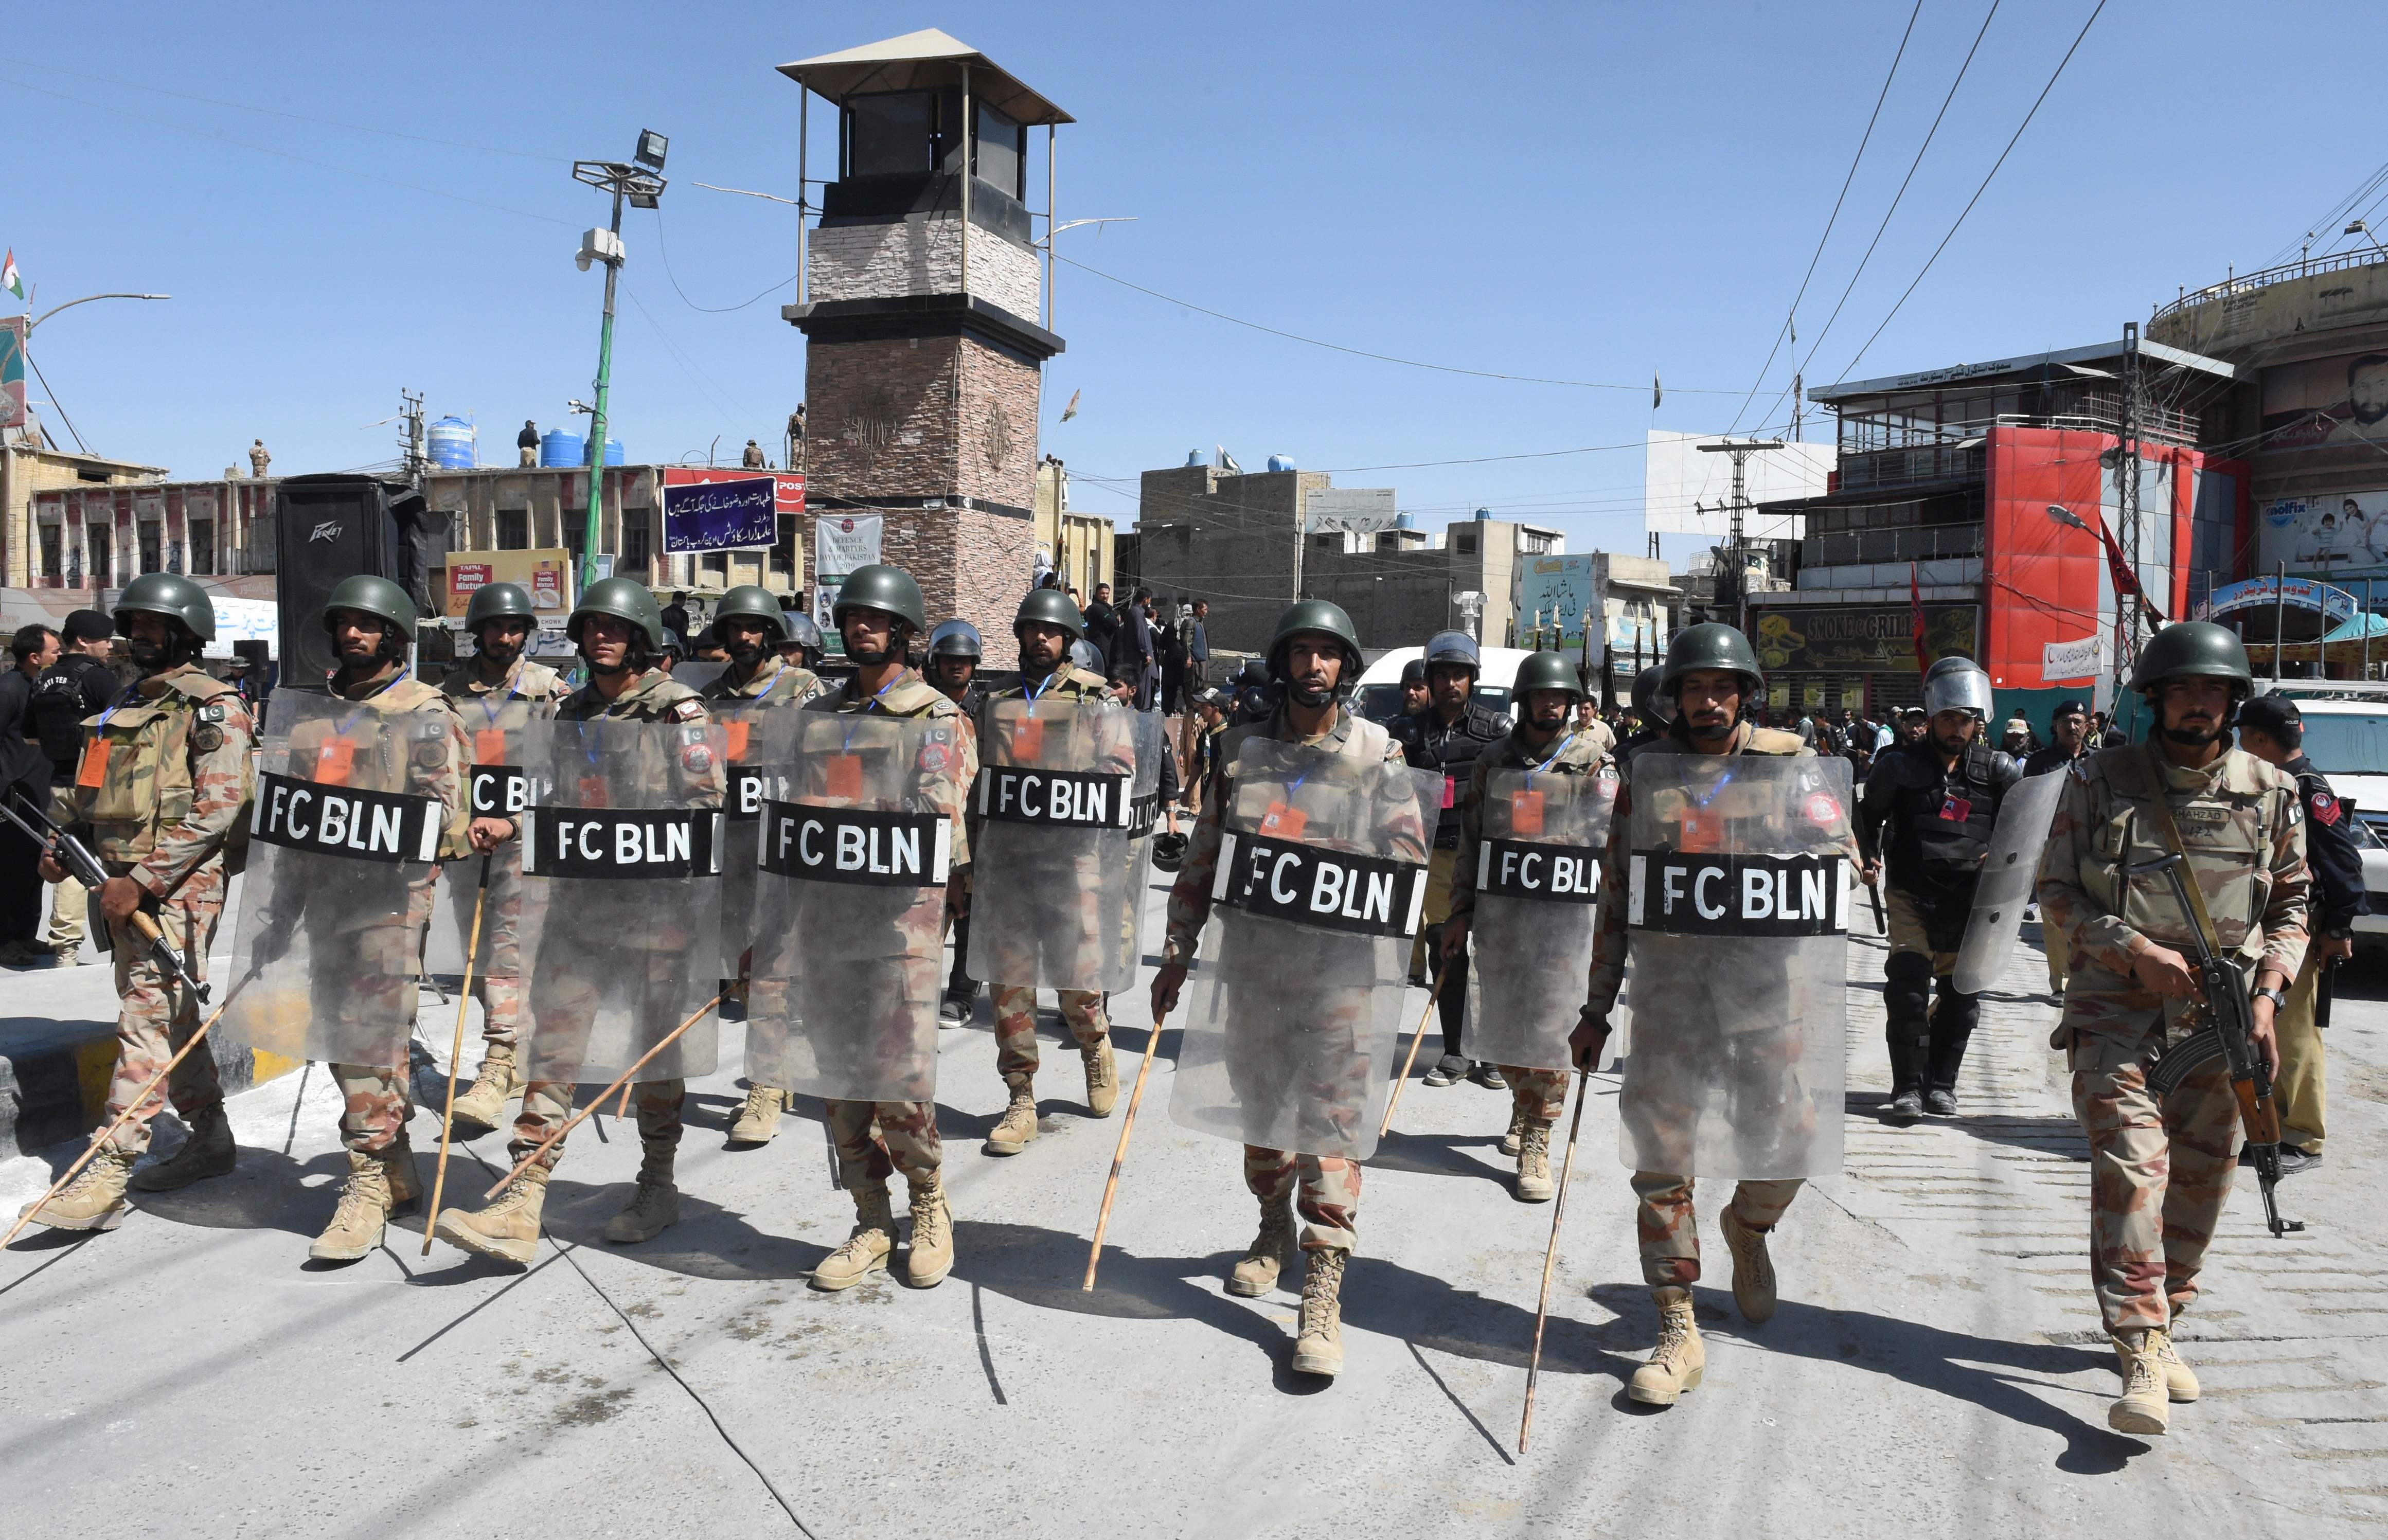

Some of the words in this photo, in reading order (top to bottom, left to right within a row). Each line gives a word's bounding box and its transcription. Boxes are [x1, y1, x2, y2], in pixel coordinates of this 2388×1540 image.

[457, 573, 484, 582] Family
[1808, 616, 1853, 640] SMOKE
[473, 774, 495, 811] C
[1000, 774, 1042, 817] FC
[1049, 778, 1107, 822] BLN
[2172, 809, 2221, 819] SHAHZAD
[269, 785, 312, 839] FC
[318, 795, 402, 853] BLN
[559, 821, 603, 860] FC
[616, 822, 690, 864] BLN
[779, 817, 824, 866] FC
[836, 824, 921, 874] BLN
[1243, 846, 1302, 904] FC
[1310, 861, 1394, 923] BLN
[1501, 851, 1542, 889] FC
[1551, 856, 1601, 893] BLN
[1664, 866, 1726, 920] FC
[1742, 868, 1826, 920] BLN
